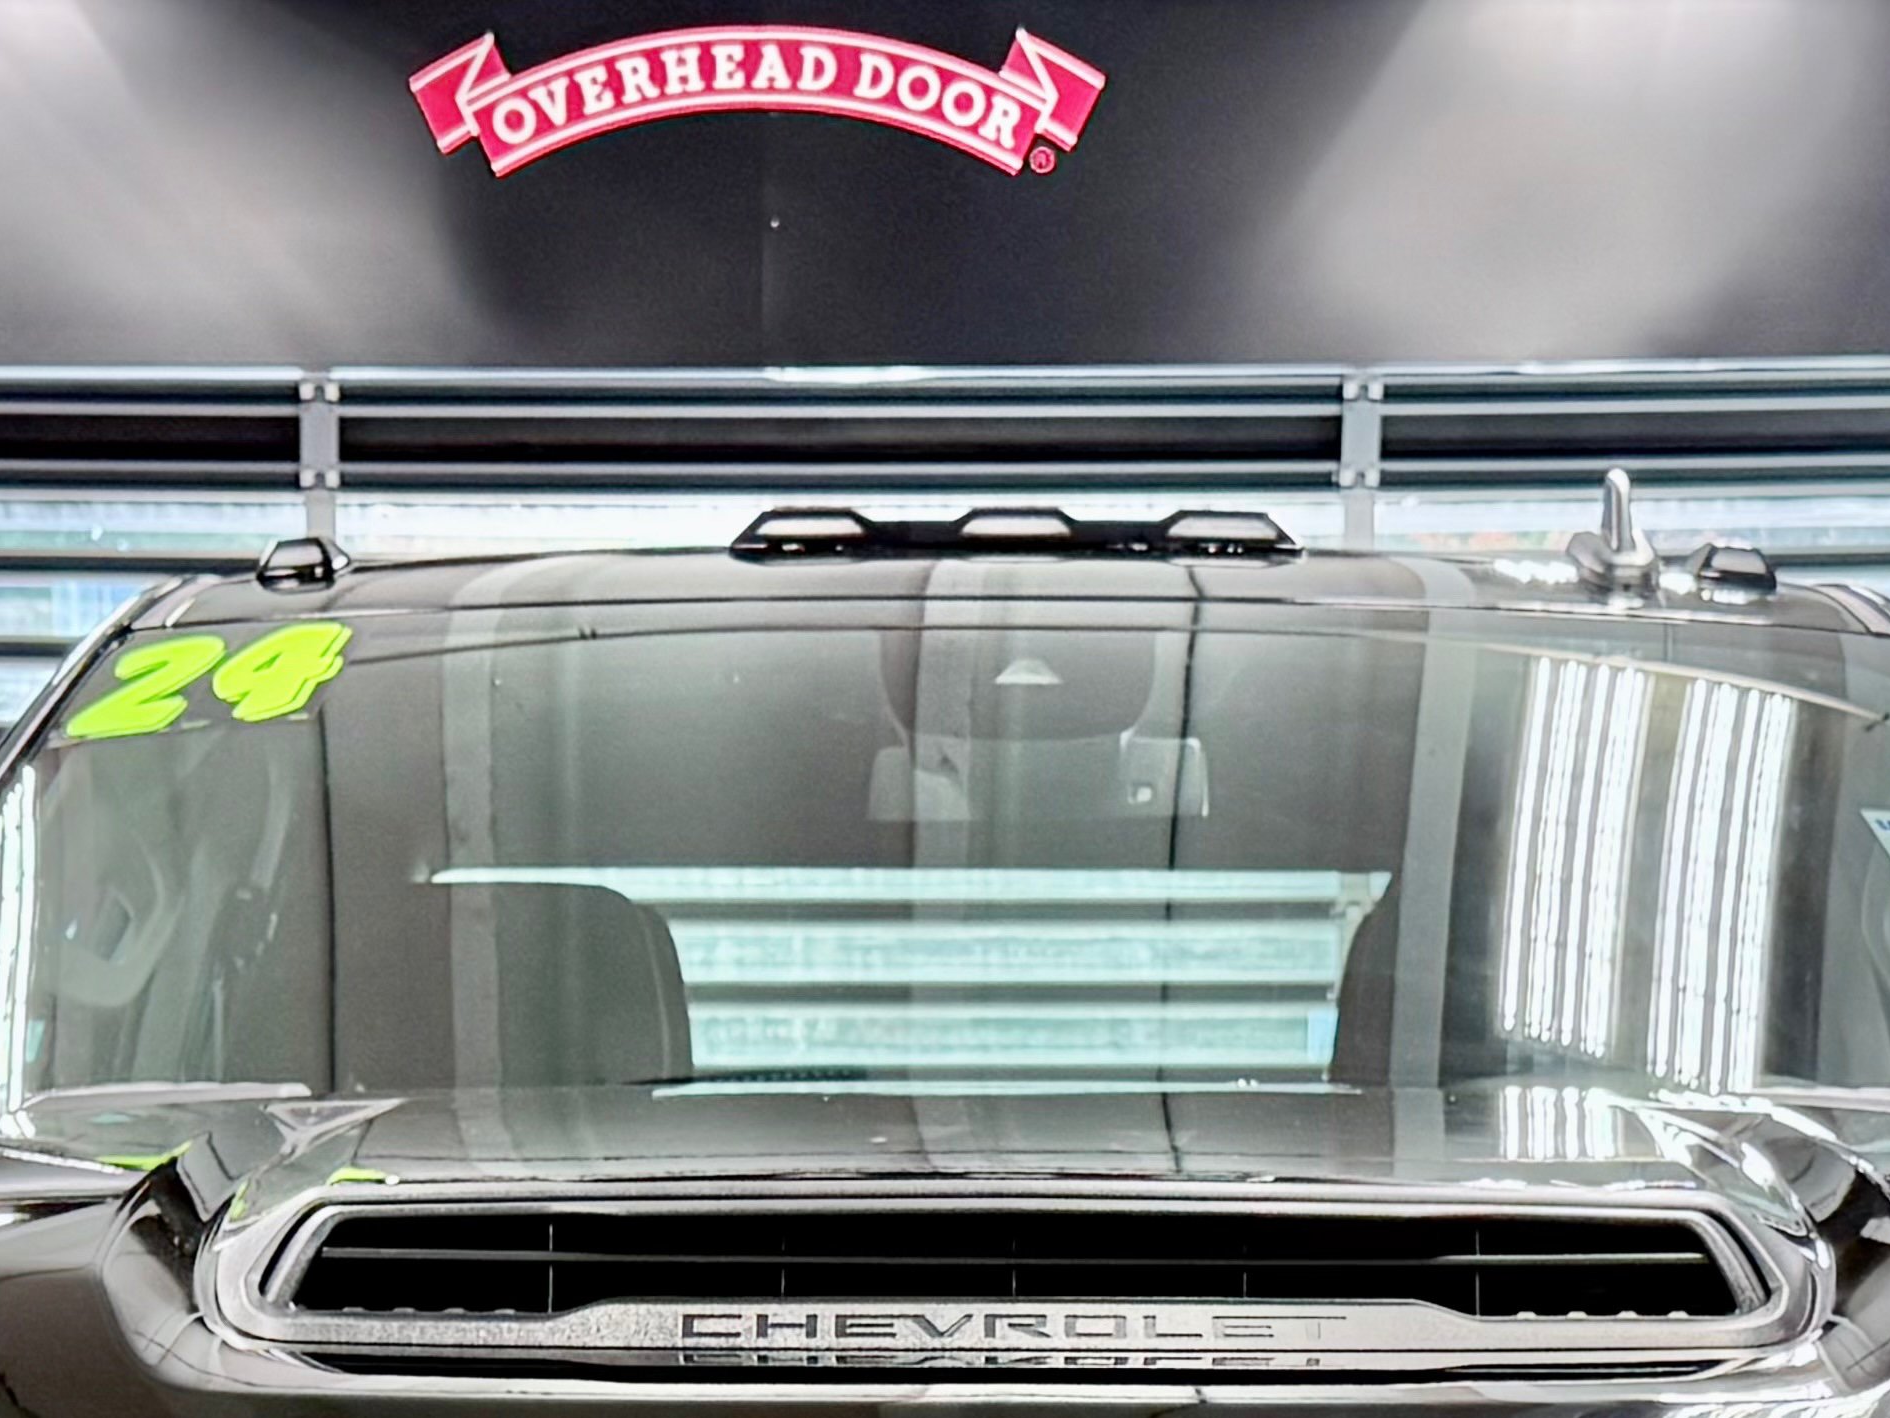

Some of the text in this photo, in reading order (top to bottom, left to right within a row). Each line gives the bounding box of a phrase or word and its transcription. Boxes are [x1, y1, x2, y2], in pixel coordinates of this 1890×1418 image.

[491, 43, 1022, 149] OVERHEAD DOOR
[65, 620, 353, 740] 24
[681, 1313, 1349, 1340] CHEVROLET
